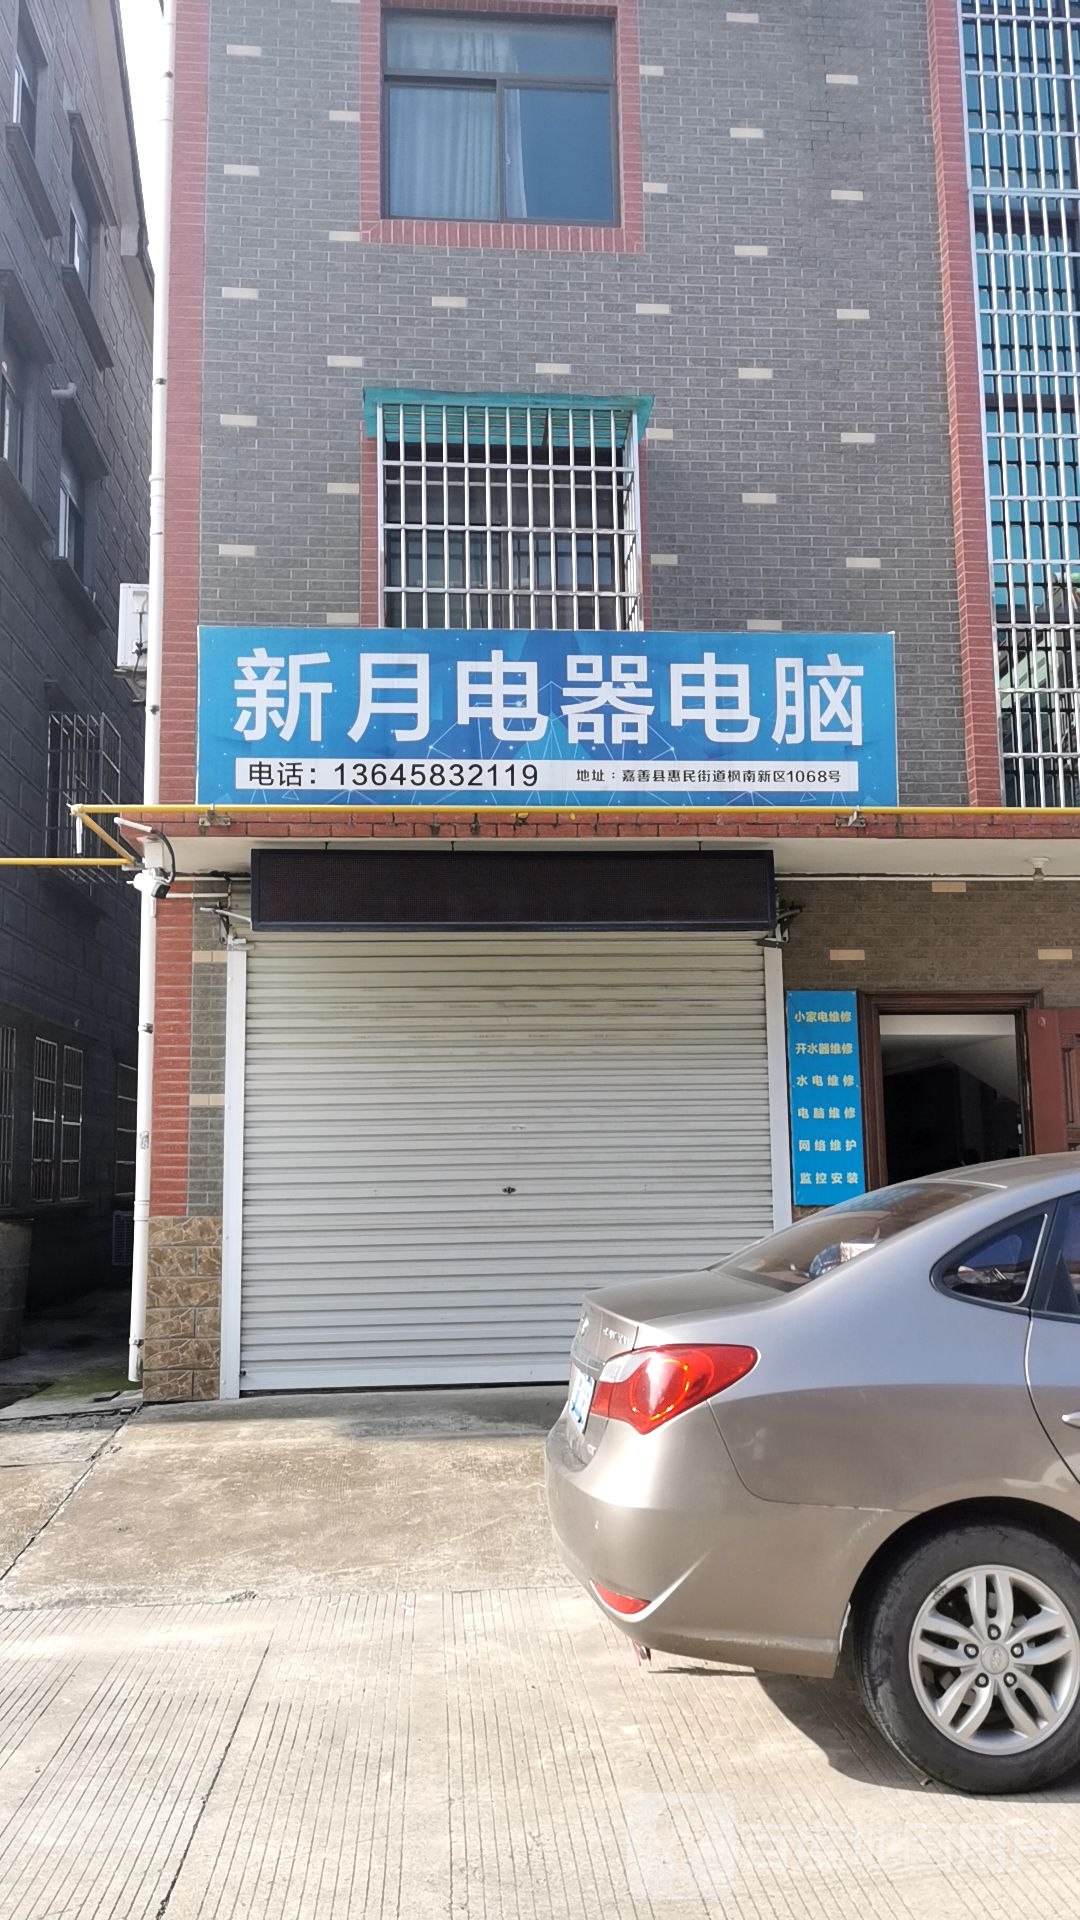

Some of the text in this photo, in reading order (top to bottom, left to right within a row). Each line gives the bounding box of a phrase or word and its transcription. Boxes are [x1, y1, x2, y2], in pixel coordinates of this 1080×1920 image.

[234, 648, 864, 746] 新月电器电脑
[794, 1011, 852, 1023] 小家电维修
[795, 1043, 853, 1055] 开水器维修
[796, 1075, 855, 1087] 水电维修
[797, 1107, 856, 1119] 电脑维修
[798, 1139, 857, 1152] 网络维护
[800, 1172, 859, 1185] 监控安装
